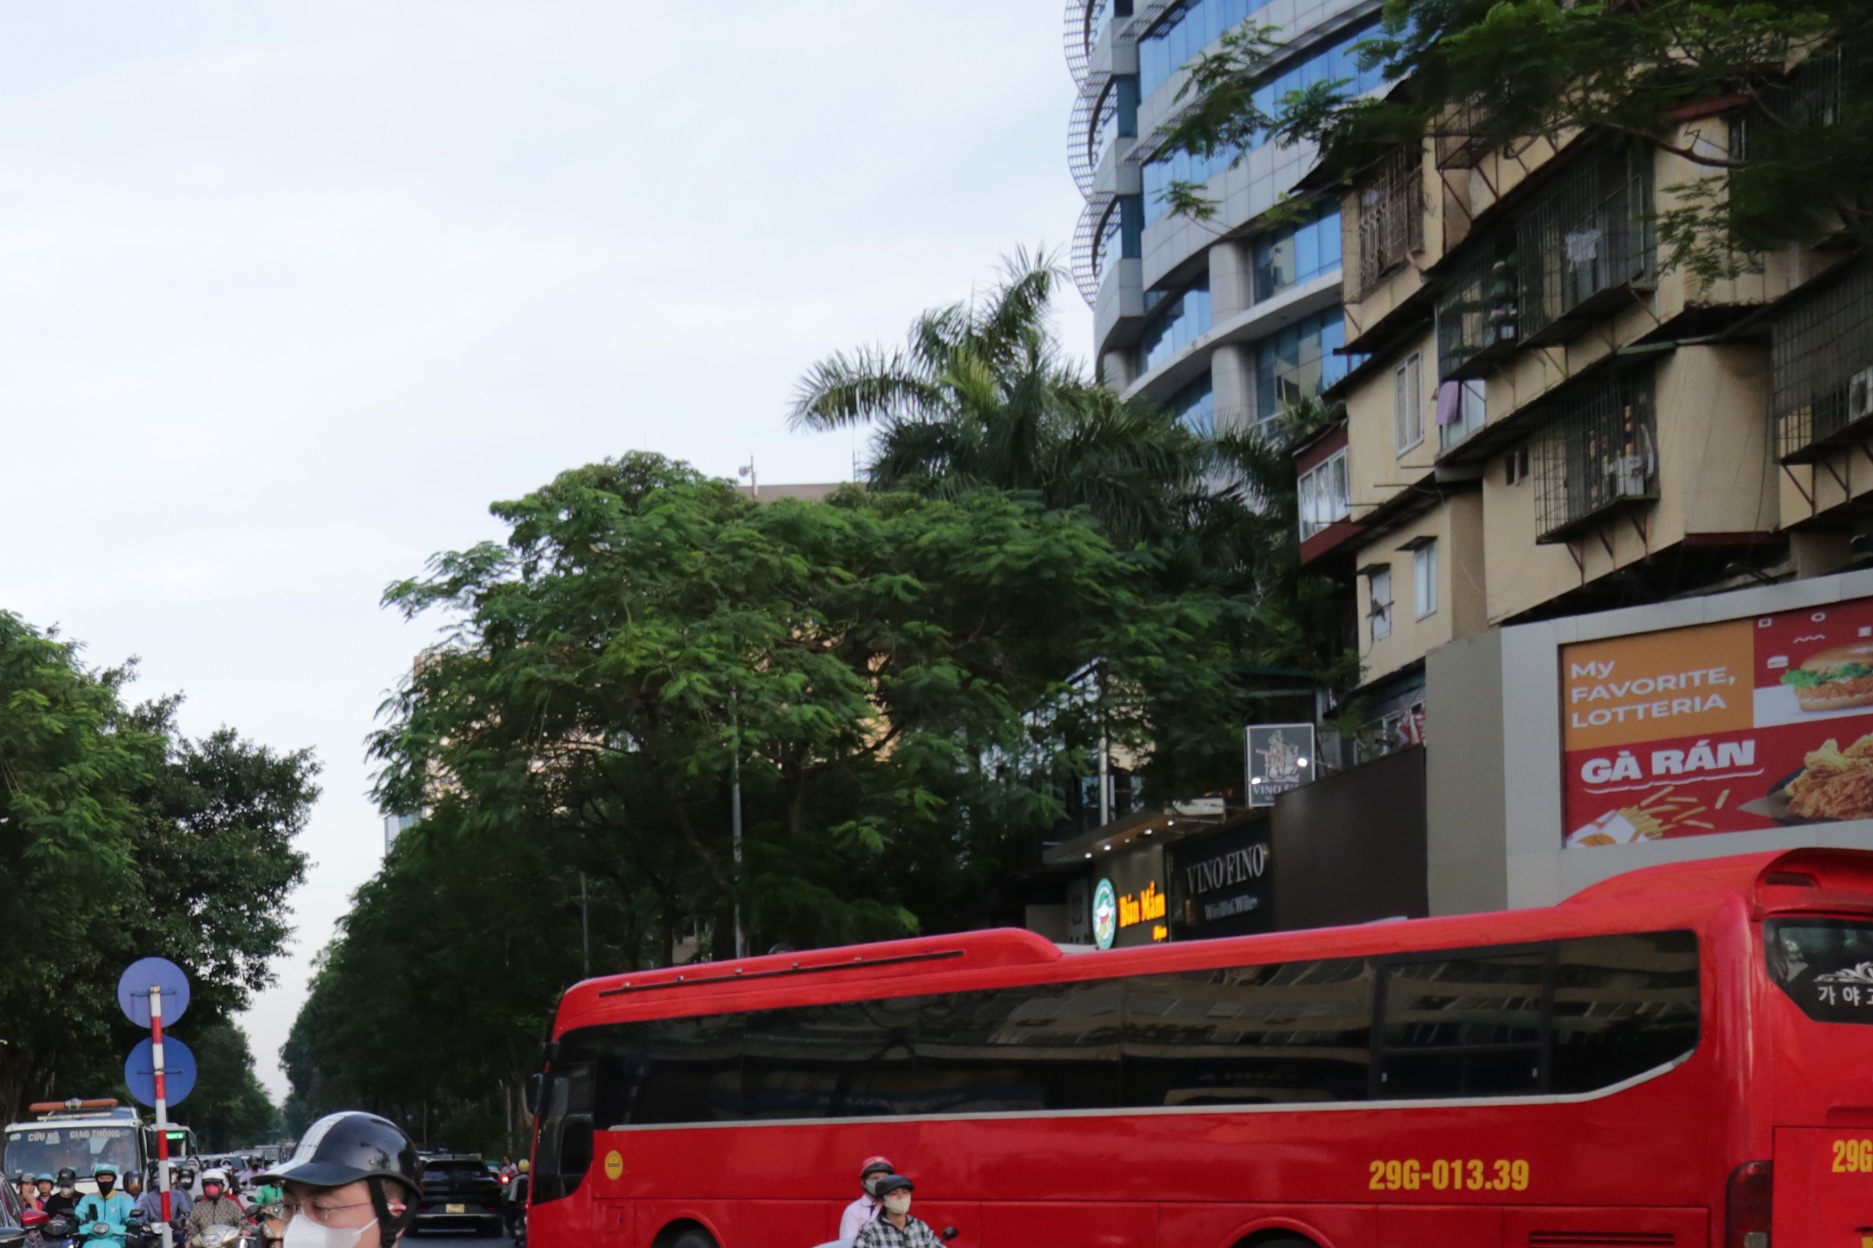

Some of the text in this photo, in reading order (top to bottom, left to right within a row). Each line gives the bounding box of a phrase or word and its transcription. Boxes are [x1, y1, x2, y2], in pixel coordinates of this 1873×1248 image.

[1571, 660, 1615, 679] My
[1571, 666, 1736, 703] FAVORITE,
[1572, 693, 1727, 728] LOTTERIA
[1581, 739, 1755, 783] GÀ RÁN
[1186, 843, 1265, 894] VINO FINO
[70, 1130, 89, 1139] GIAO
[1369, 1159, 1530, 1191] 29G-013.39
